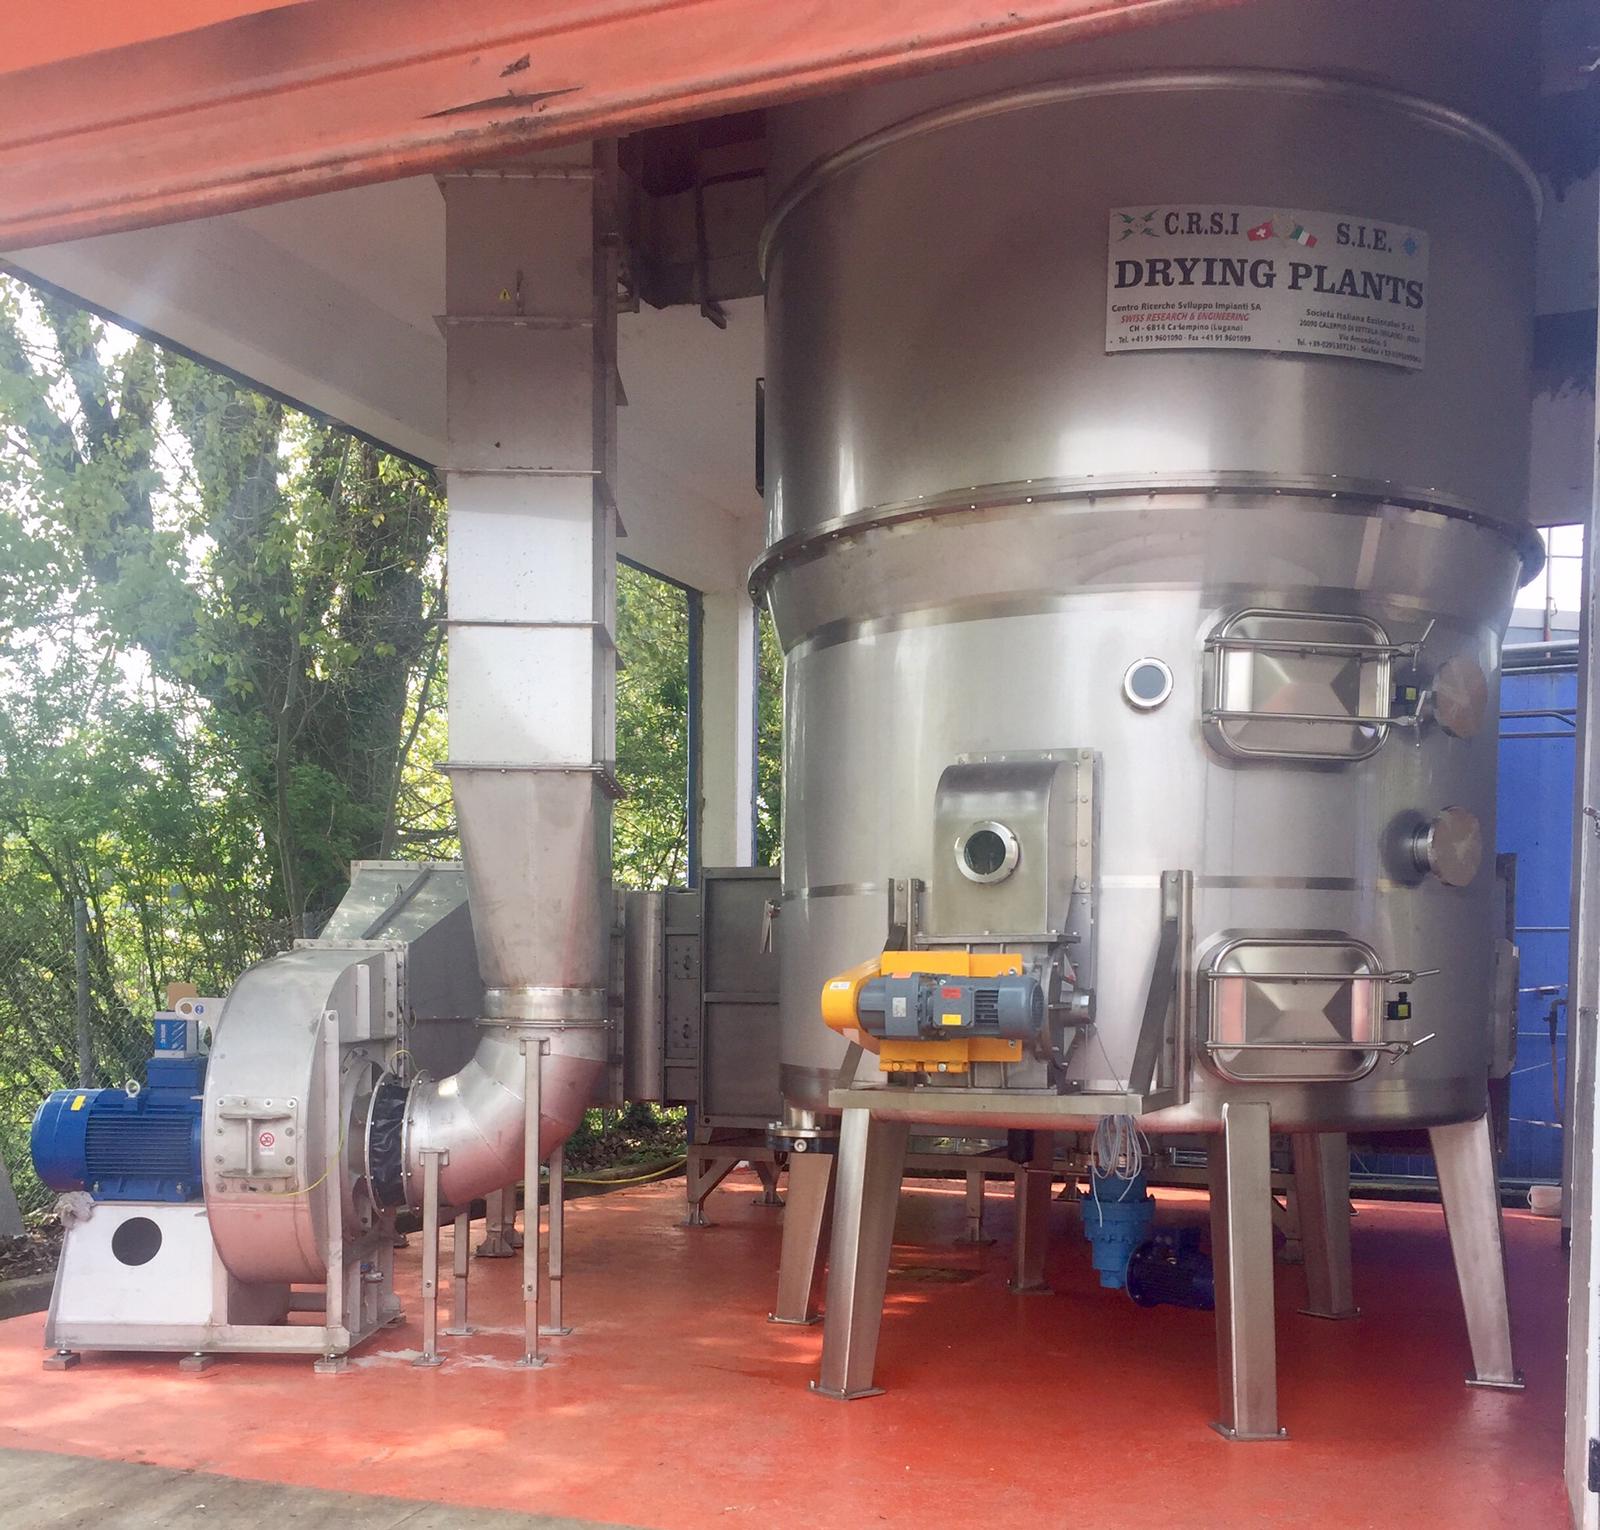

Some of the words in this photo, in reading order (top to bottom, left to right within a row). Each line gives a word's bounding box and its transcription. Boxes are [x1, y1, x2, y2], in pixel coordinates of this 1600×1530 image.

[1336, 222, 1392, 253] S.I.E.
[1114, 257, 1277, 289] DRYING
[1288, 261, 1424, 310] PLANTS
[1112, 303, 1139, 312] Centro
[1141, 301, 1176, 310] Ricerche
[1178, 301, 1213, 311] Sviluppo
[1215, 301, 1249, 311] Impianti
[1251, 302, 1262, 311] SA
[1121, 313, 1145, 324] SWISS
[1147, 312, 1188, 321] RESEARCH
[1197, 311, 1250, 321] ENGINEERING
[1129, 324, 1140, 332] CH
